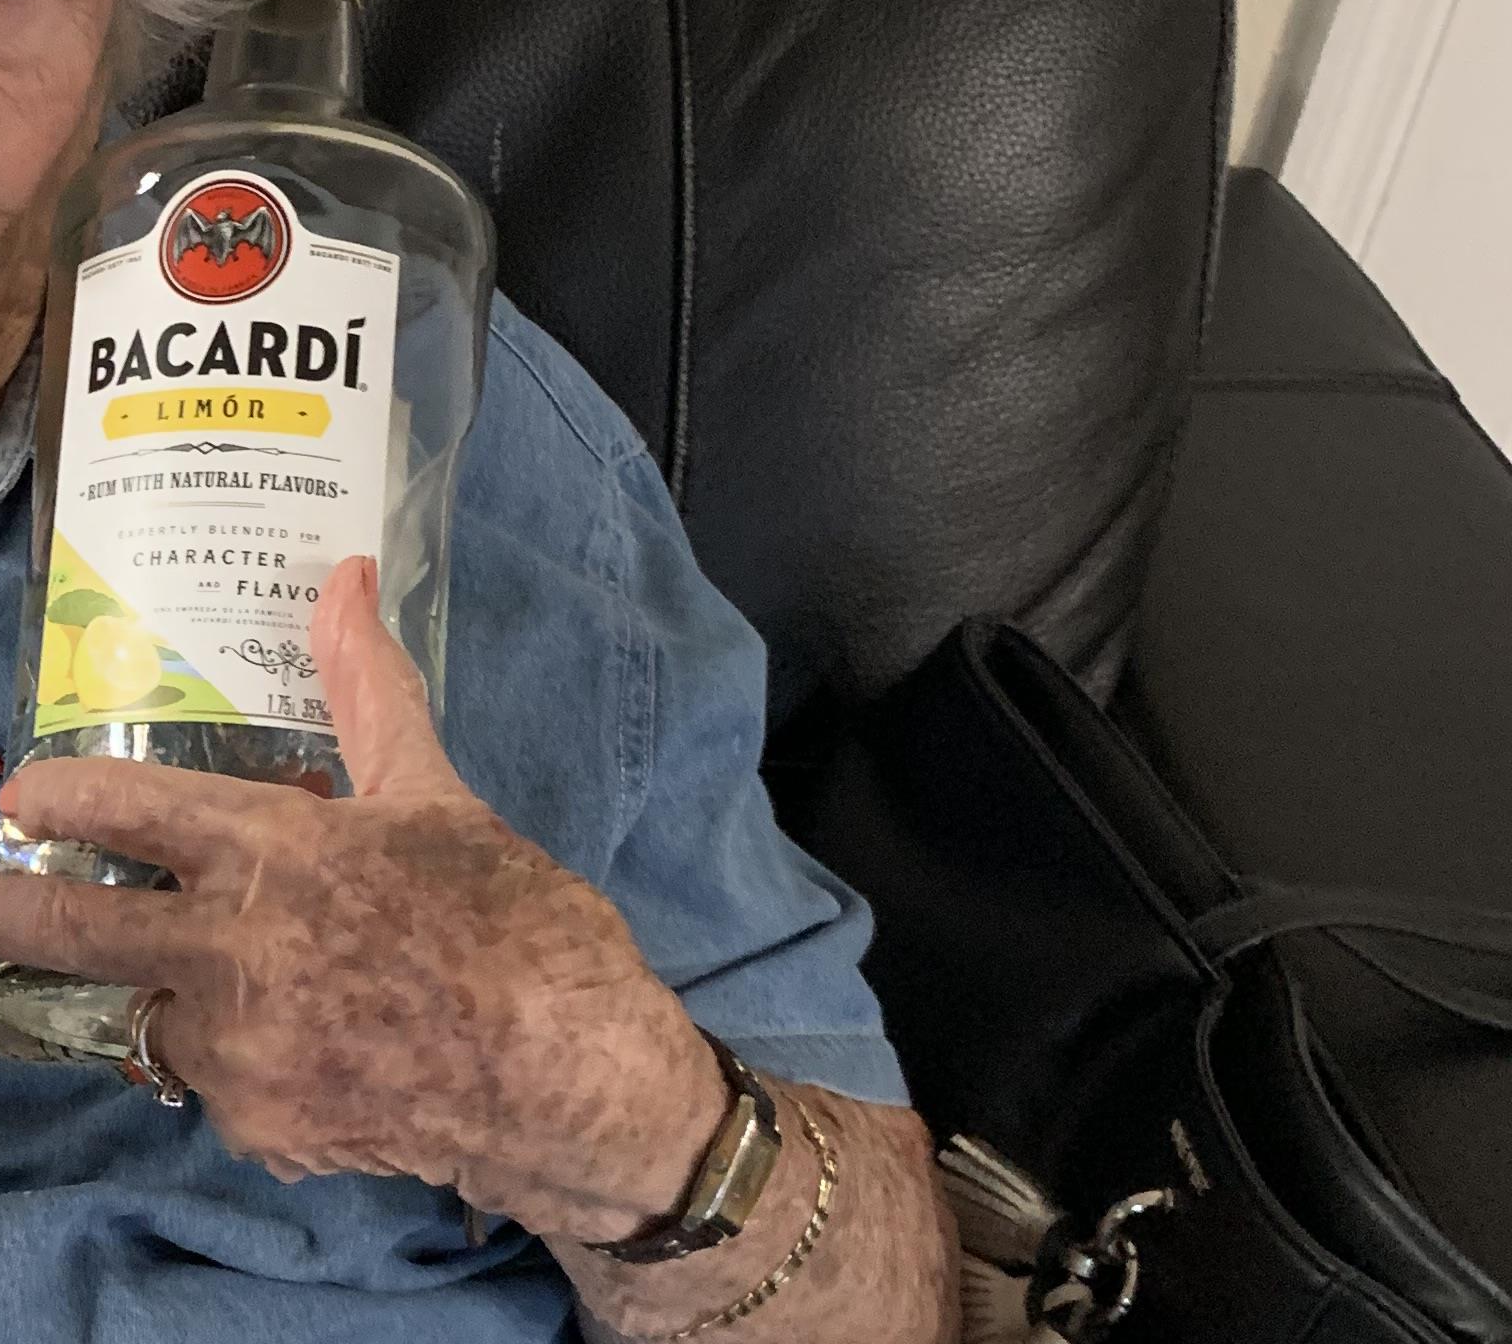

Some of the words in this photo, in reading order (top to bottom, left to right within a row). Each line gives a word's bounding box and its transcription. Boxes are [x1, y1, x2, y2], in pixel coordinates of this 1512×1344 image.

[88, 317, 366, 394] BACARDÍ
[157, 394, 265, 421] LIMÓN
[88, 479, 117, 501] RUM
[122, 473, 164, 493] WITH
[170, 471, 253, 489] NATURAL
[259, 472, 338, 498] FLAVORS
[118, 525, 199, 539] EXPERTLY
[208, 524, 289, 539] BLENDED
[133, 549, 287, 569] CHARACTER
[198, 581, 221, 589] AND
[236, 579, 320, 603] FLAVO
